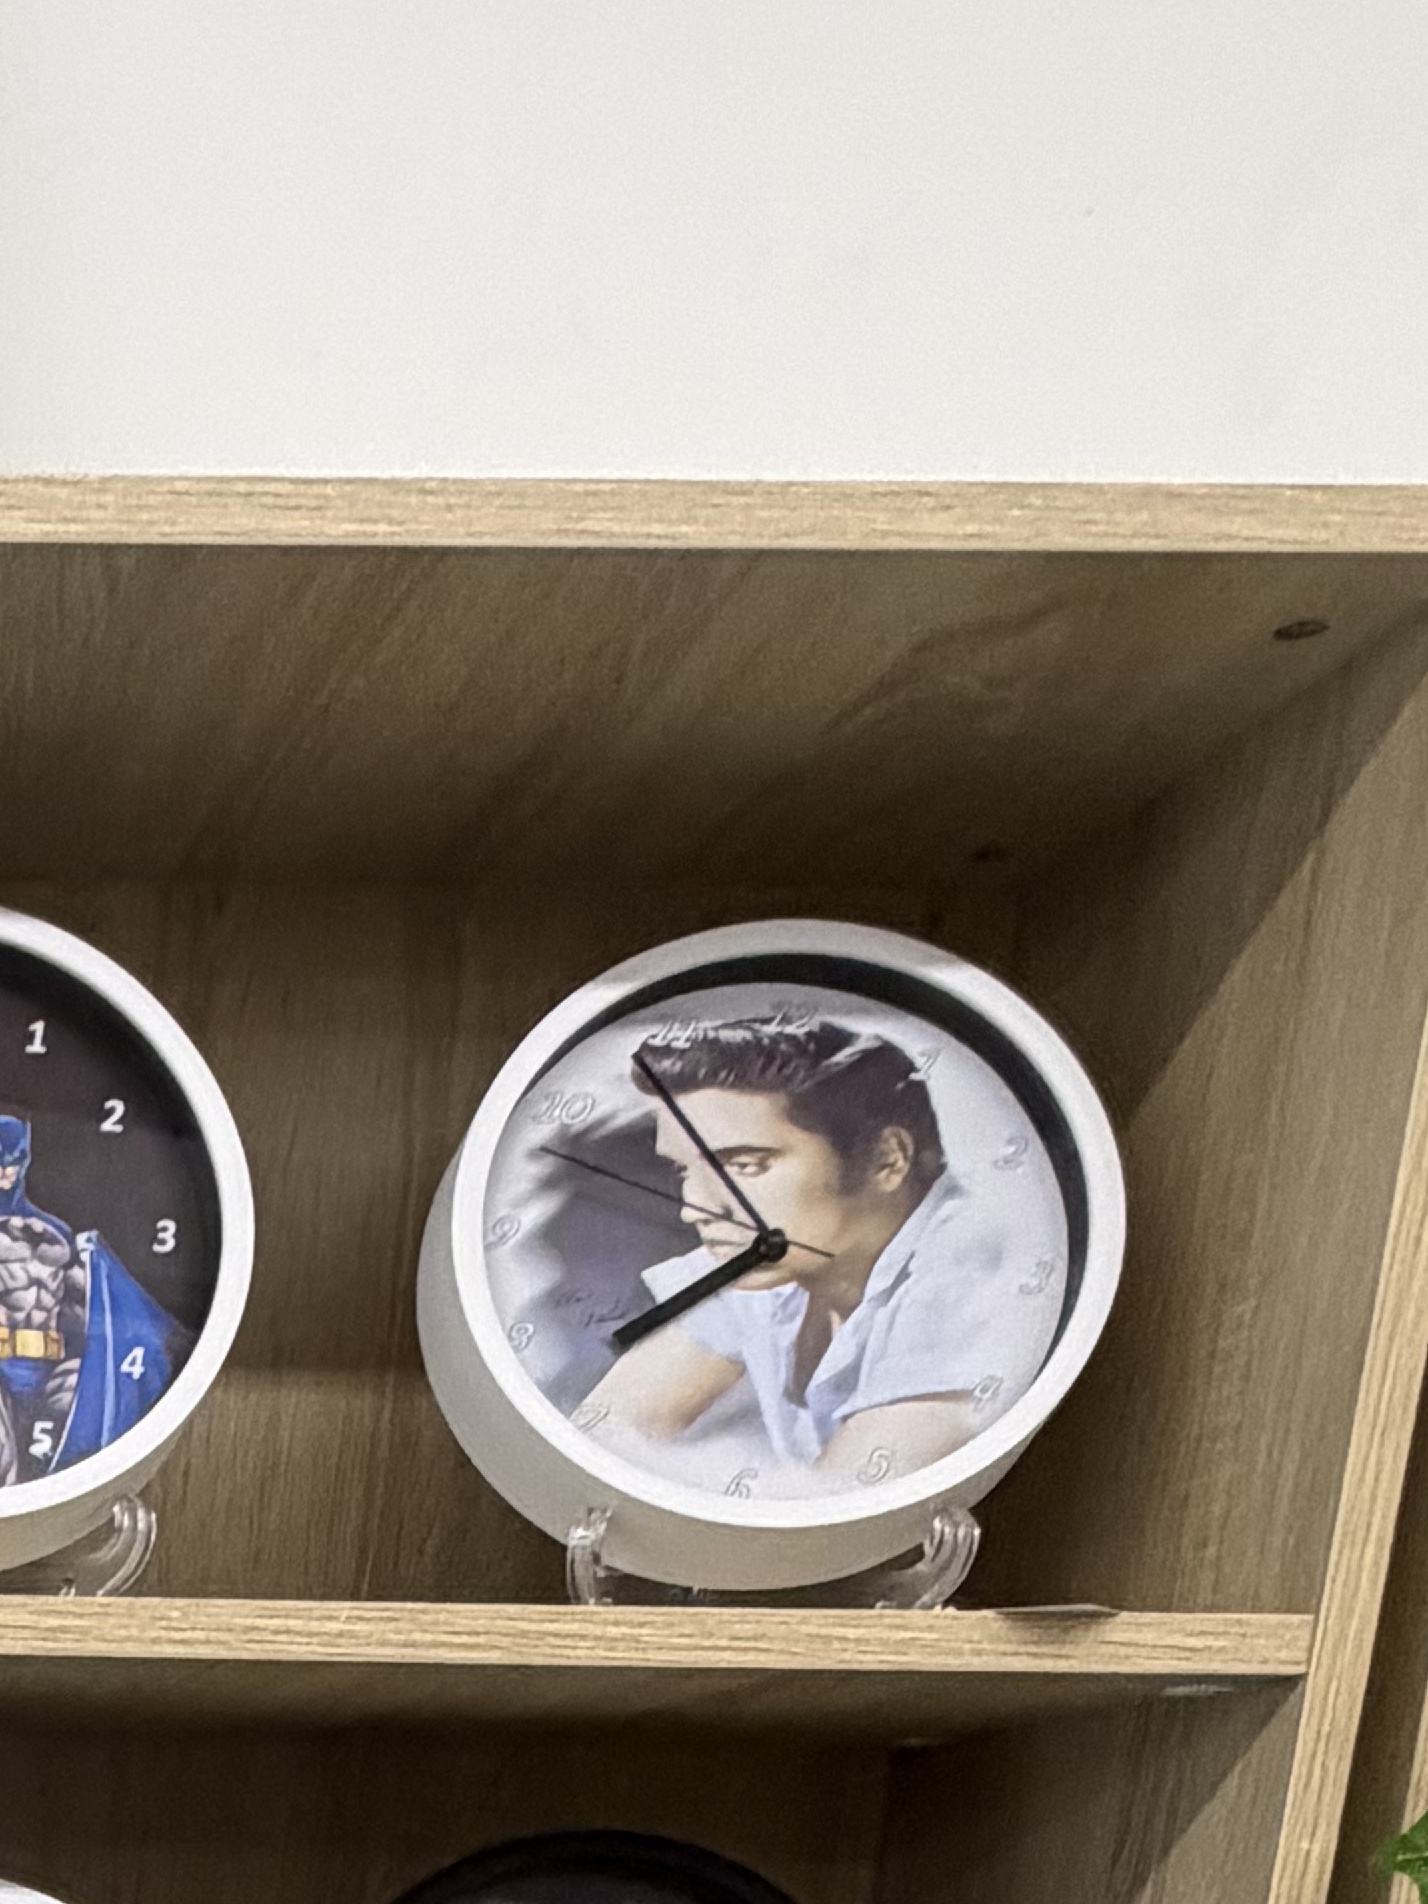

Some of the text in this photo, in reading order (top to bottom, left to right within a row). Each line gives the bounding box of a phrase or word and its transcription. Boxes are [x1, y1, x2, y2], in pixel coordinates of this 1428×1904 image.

[24, 1021, 47, 1053] 1
[100, 1100, 124, 1131] 2
[152, 1220, 176, 1253] 3
[120, 1349, 145, 1379] 4
